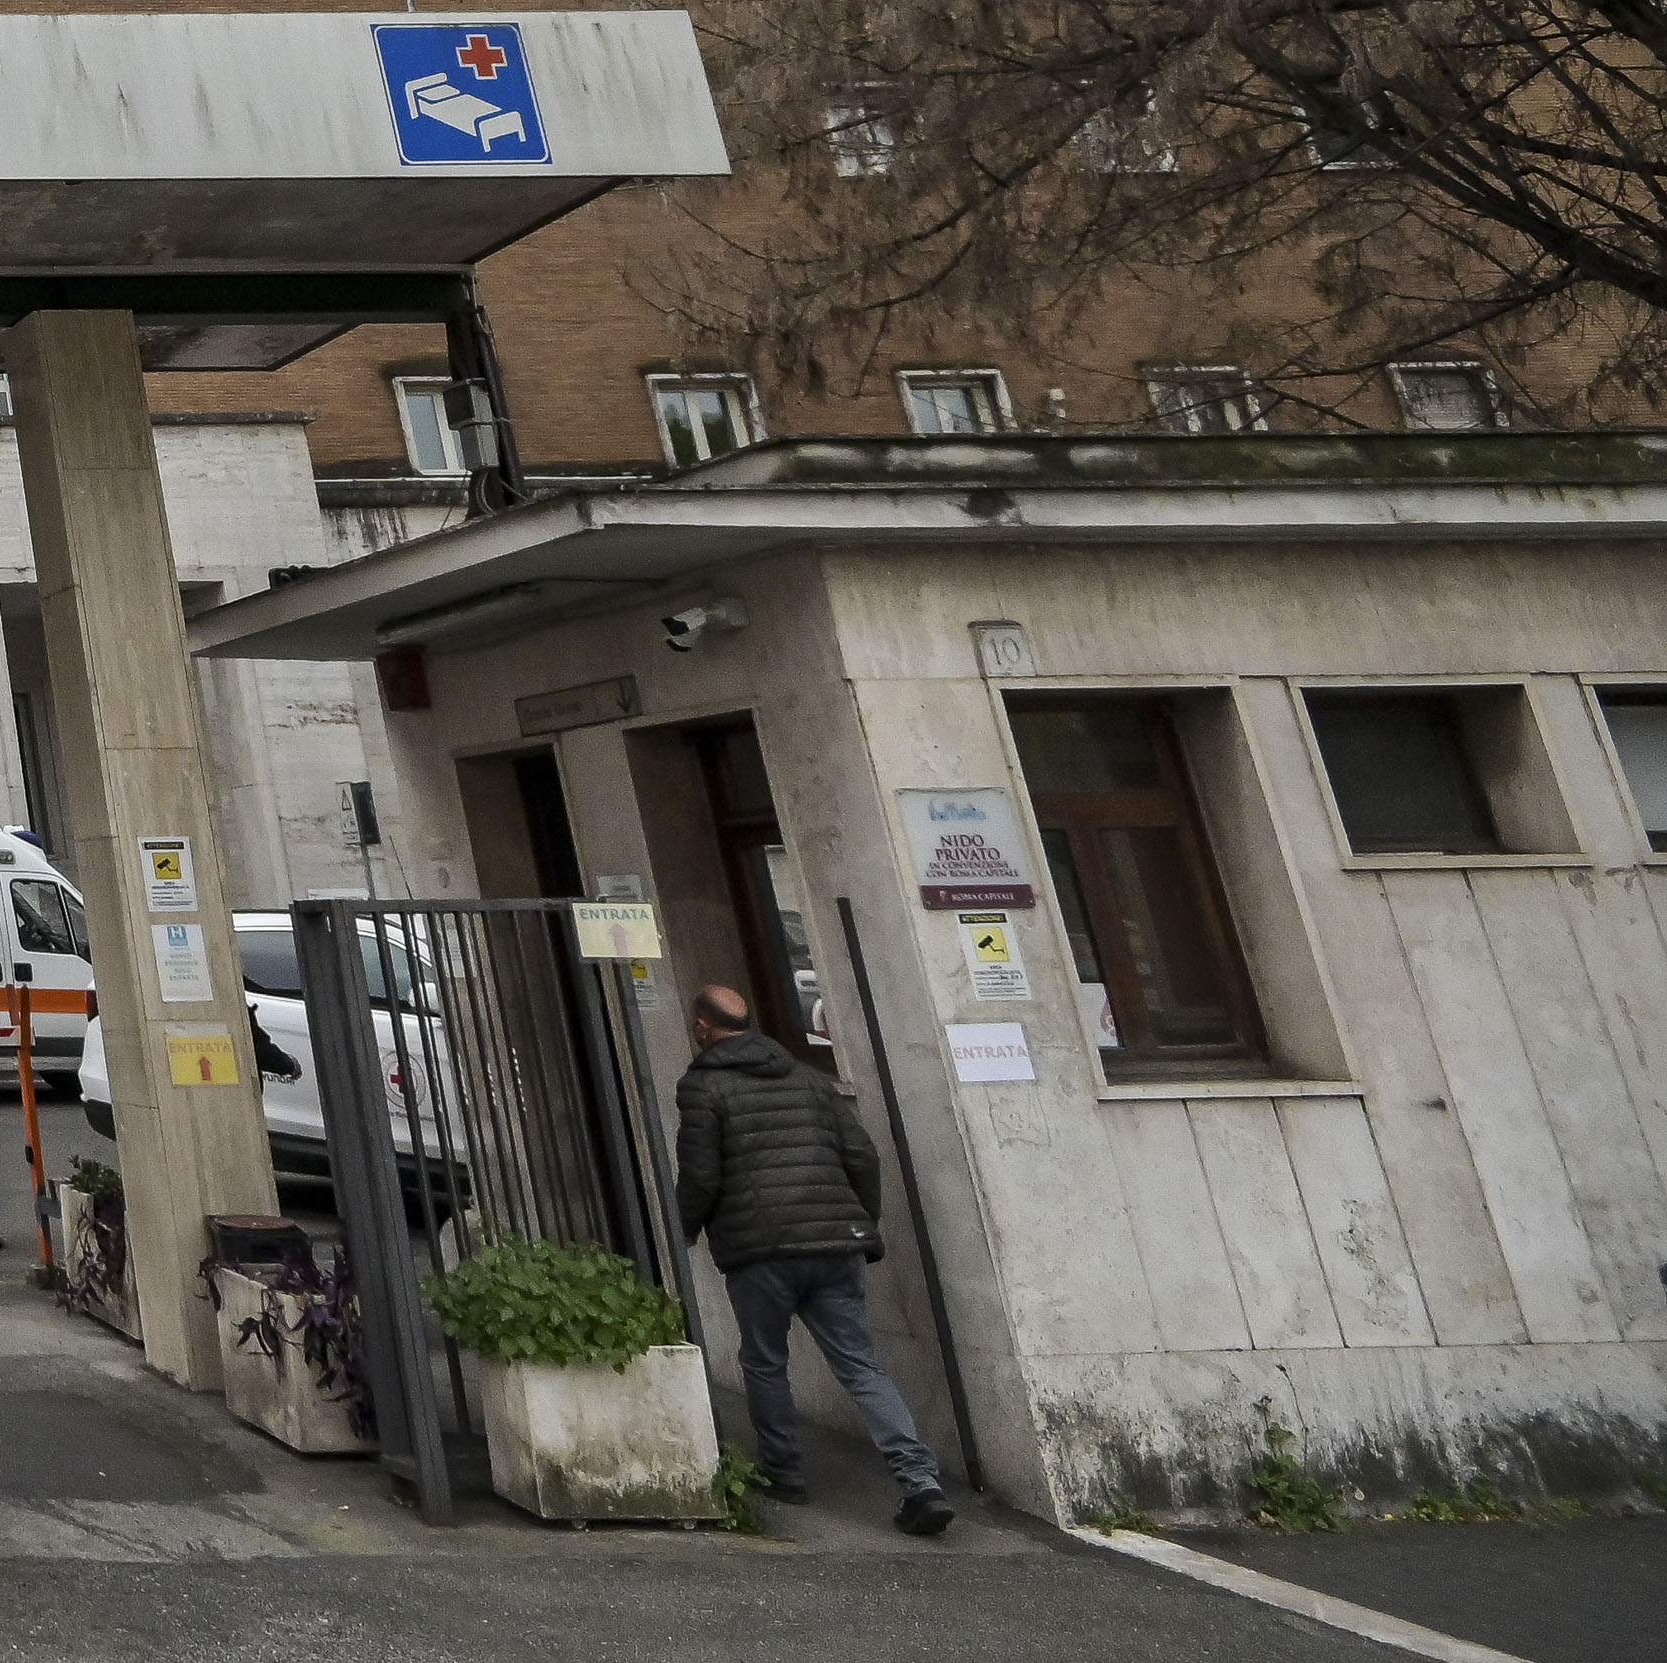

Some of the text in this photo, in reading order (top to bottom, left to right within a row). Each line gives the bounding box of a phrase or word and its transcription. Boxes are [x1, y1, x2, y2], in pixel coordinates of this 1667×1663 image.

[990, 636, 1021, 666] 10
[940, 833, 985, 847] NIDO
[935, 847, 1001, 861] PRIVATO
[578, 907, 649, 921] ENTRATA
[169, 1041, 233, 1054] ENTRATA
[954, 1045, 1028, 1060] ENTRATA
[263, 1074, 296, 1085] YUNDAI
